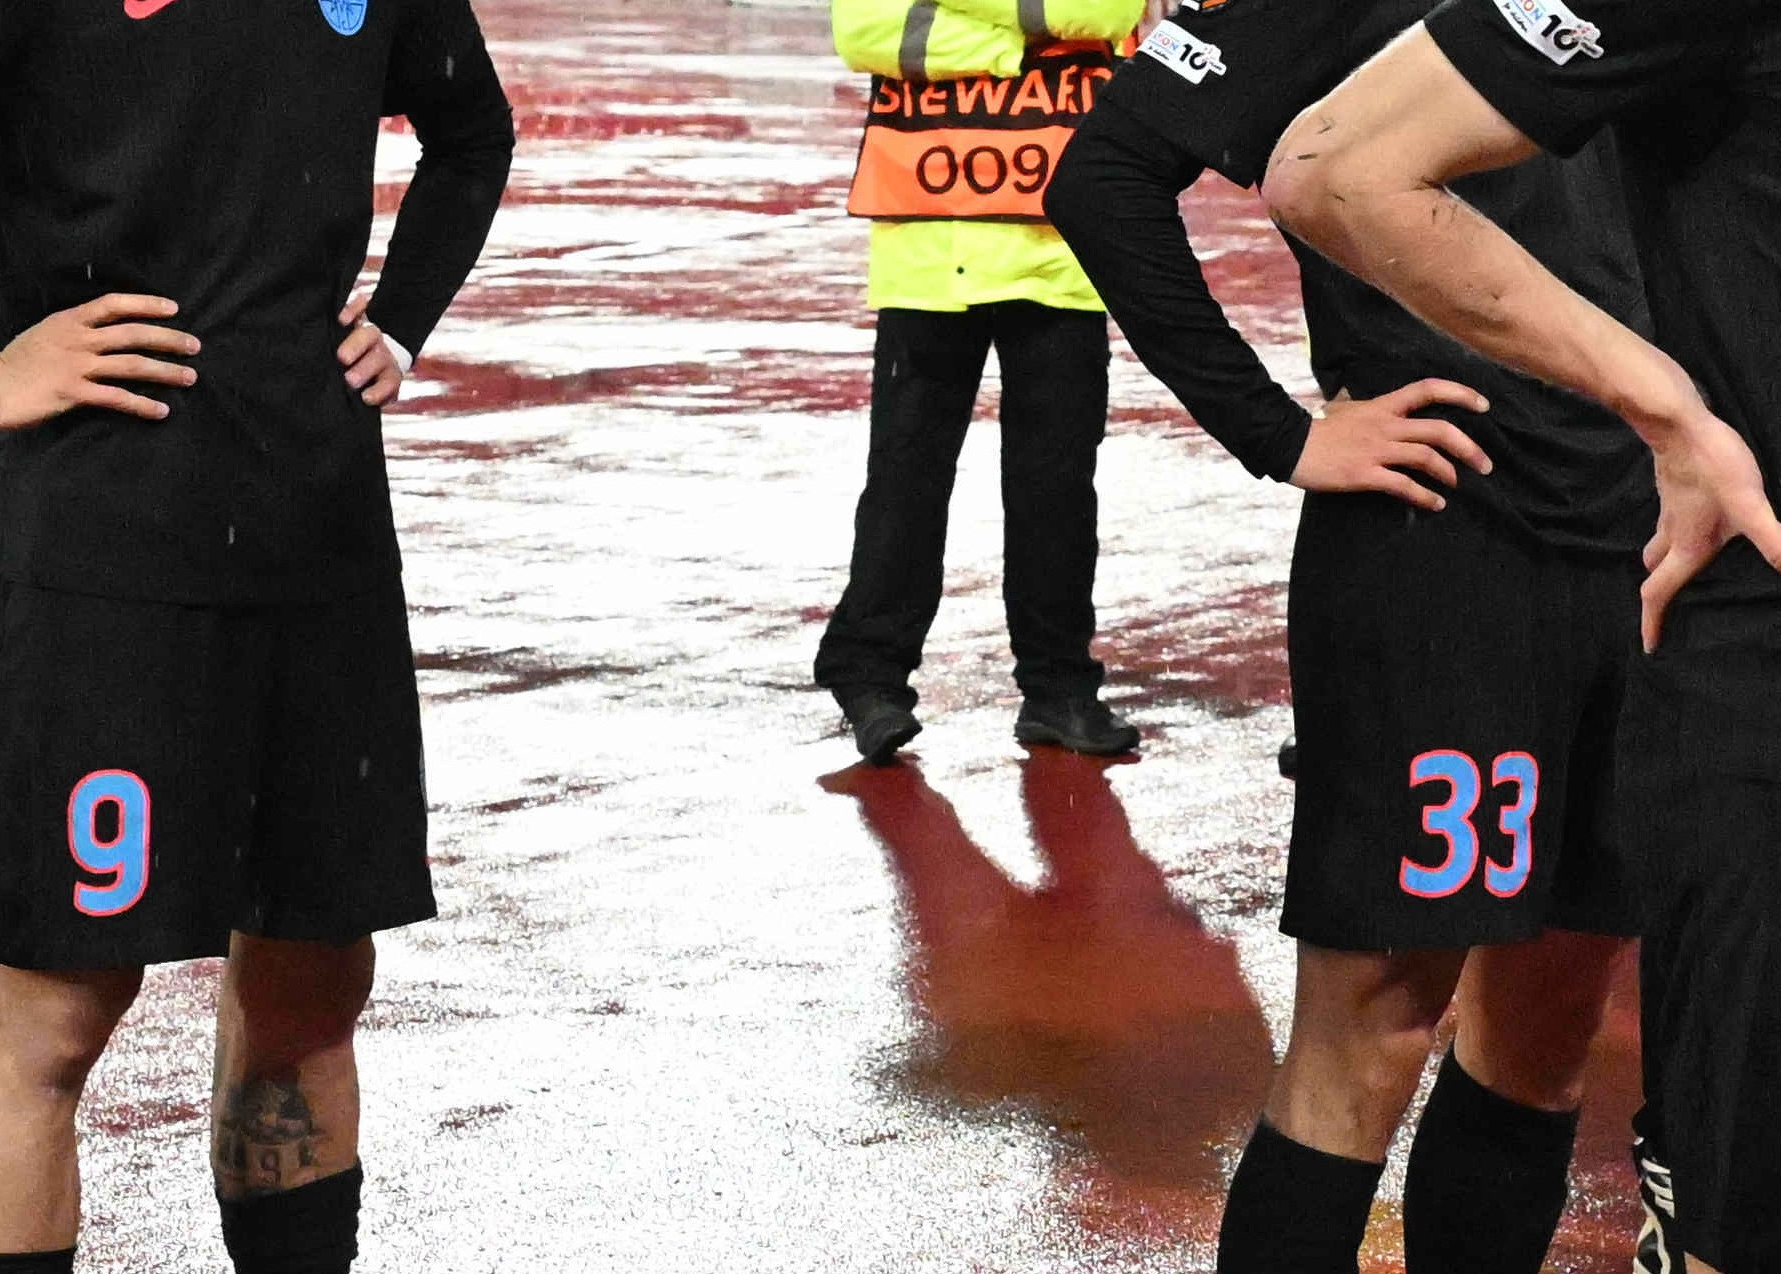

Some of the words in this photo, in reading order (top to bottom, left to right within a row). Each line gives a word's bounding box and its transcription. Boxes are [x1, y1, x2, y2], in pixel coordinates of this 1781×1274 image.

[915, 143, 1050, 195] 009
[67, 768, 152, 918] 9
[1399, 748, 1541, 899] 33
